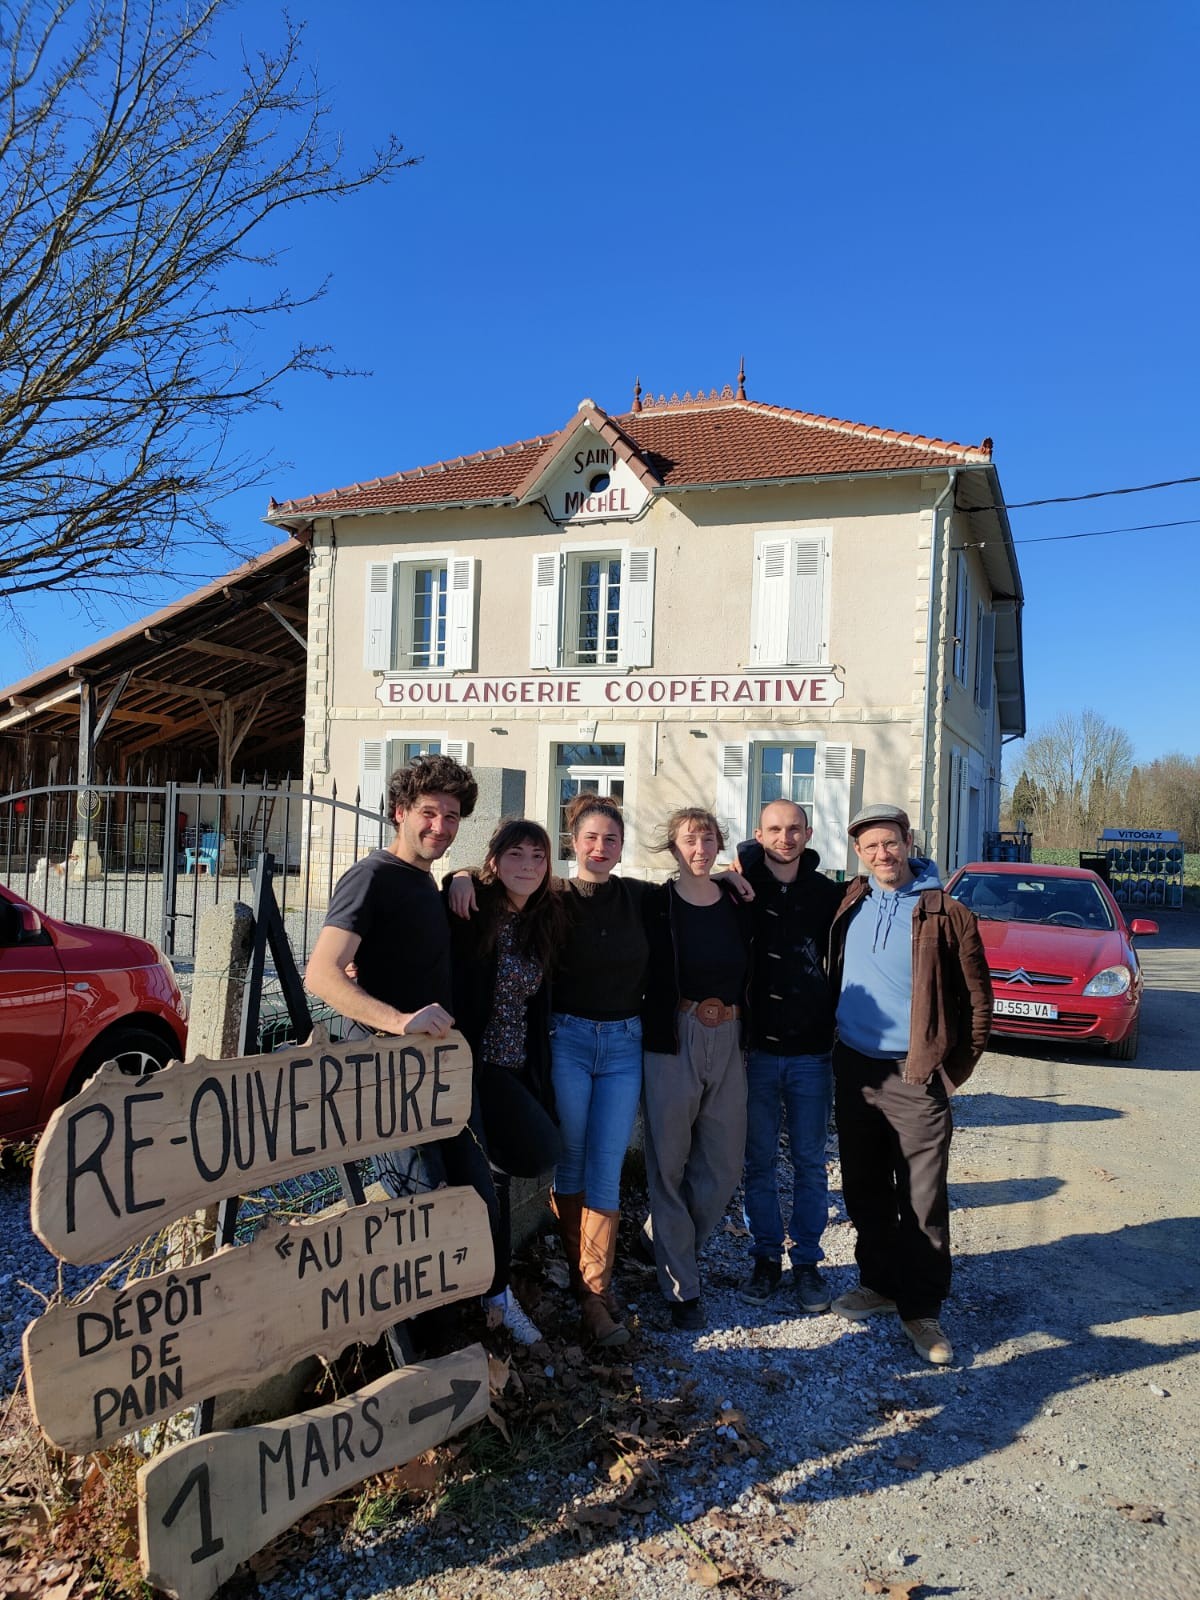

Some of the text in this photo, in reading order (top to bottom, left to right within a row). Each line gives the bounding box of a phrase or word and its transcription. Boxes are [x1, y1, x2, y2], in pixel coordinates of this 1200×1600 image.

[574, 448, 617, 474] SAINT
[564, 488, 630, 514] MICHEL
[389, 677, 828, 703] BOULANGERIE COOPÉRATIVE
[992, 1000, 1049, 1017] D-553-VA
[66, 1044, 460, 1234] RÉ-OUVERTURE
[77, 1272, 211, 1357] DÉPÔT
[131, 1332, 181, 1380] DE
[93, 1366, 184, 1440] PAIN
[162, 1396, 384, 1565] 1 MARS
